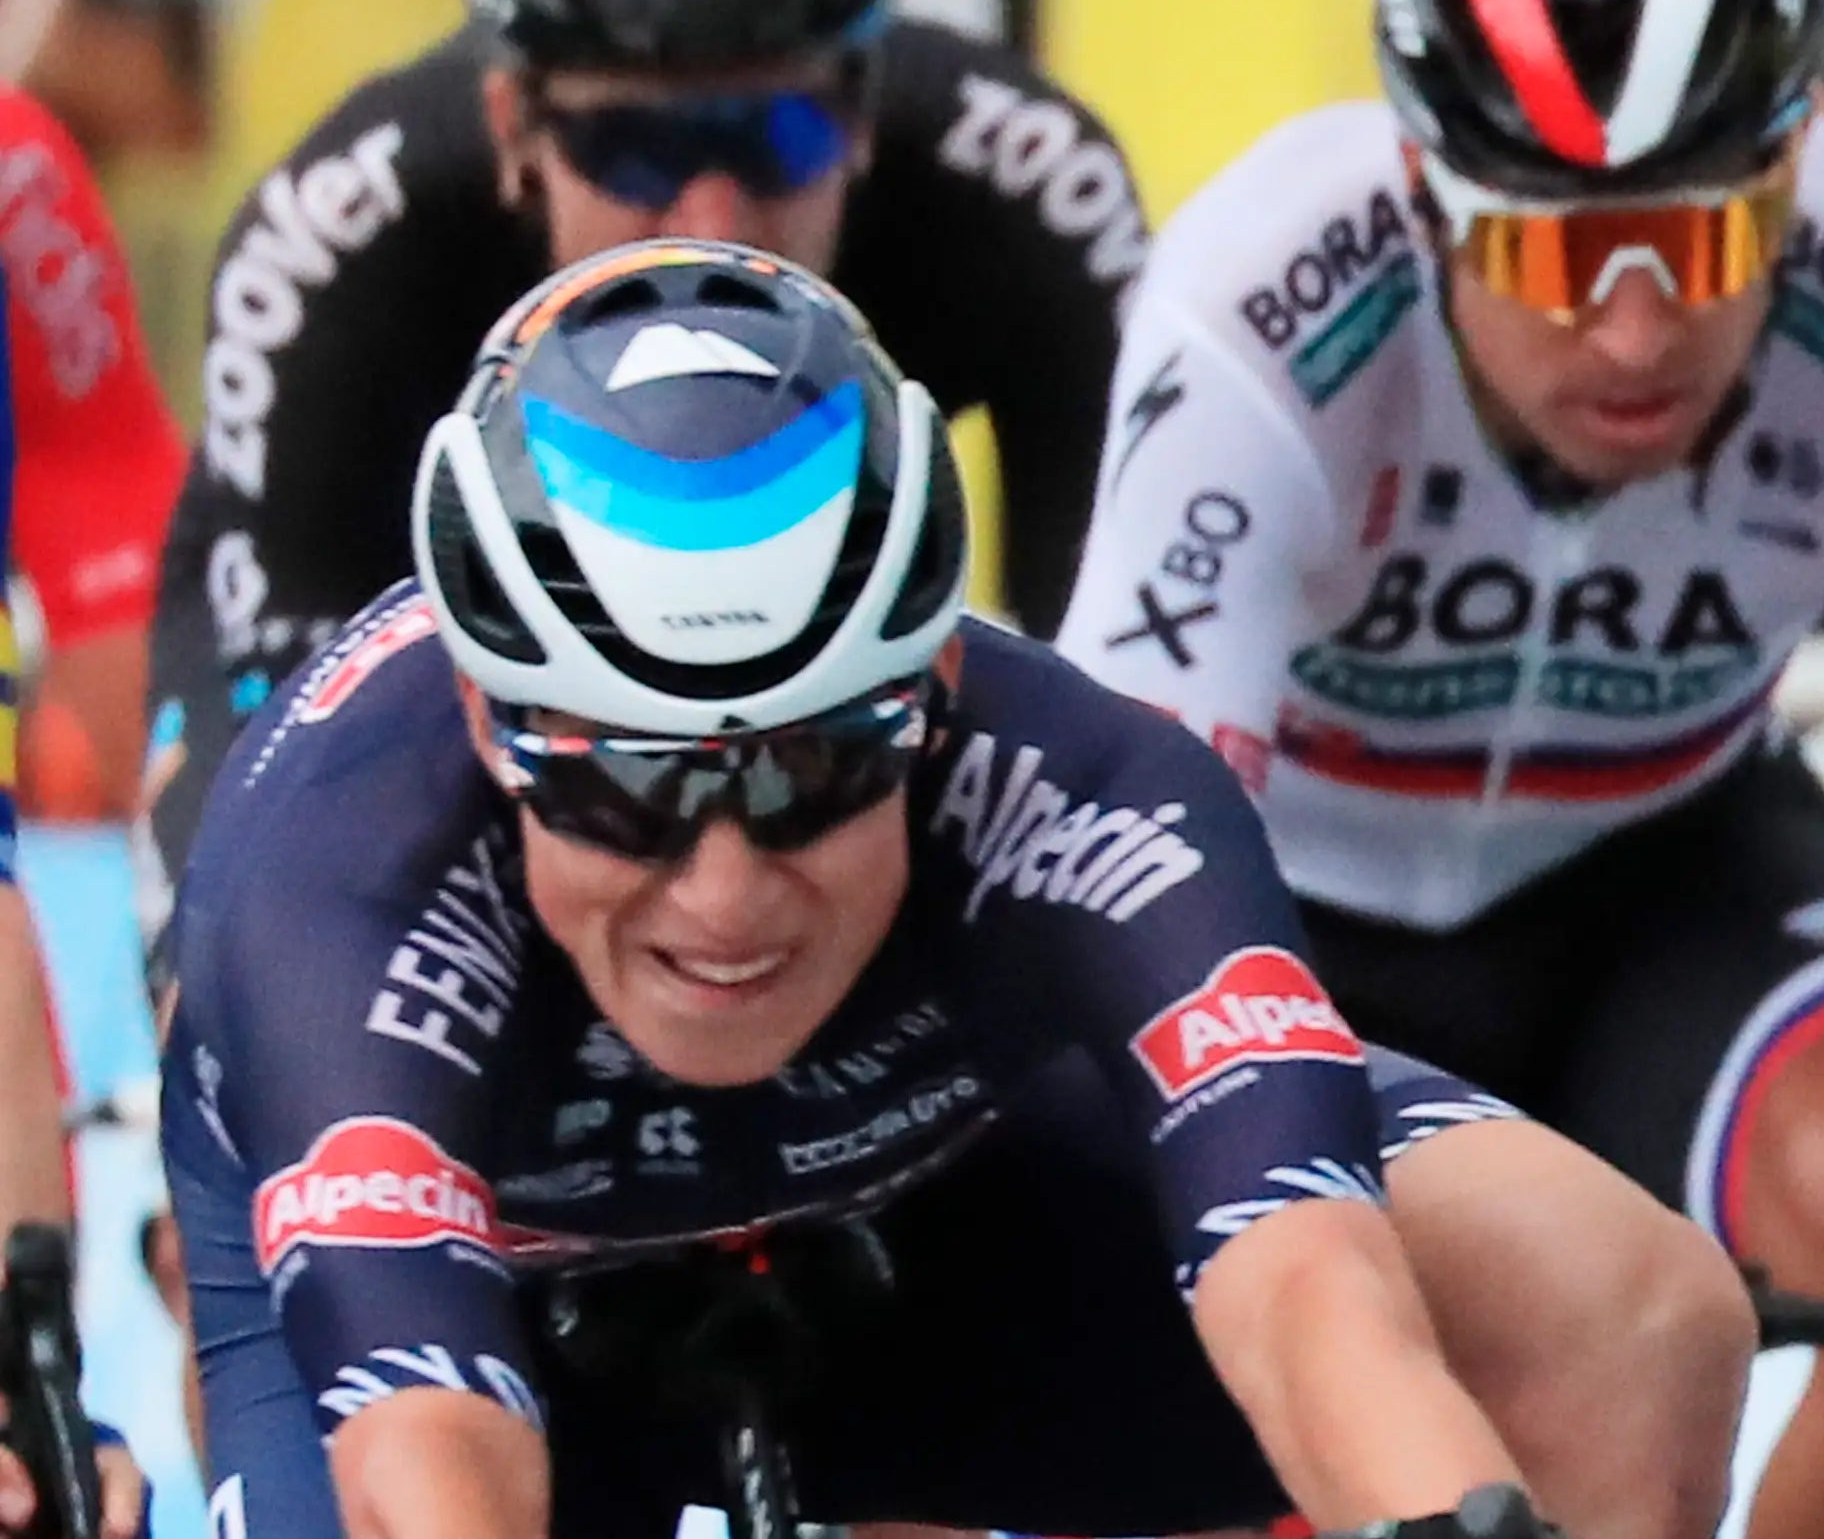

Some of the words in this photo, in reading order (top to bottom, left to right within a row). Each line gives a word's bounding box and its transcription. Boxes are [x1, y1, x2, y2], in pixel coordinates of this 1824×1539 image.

[1241, 188, 1408, 351] BORA
[1335, 552, 1758, 652] BORA
[930, 732, 1204, 924] Alpecin
[266, 1170, 489, 1243] Alpecin
